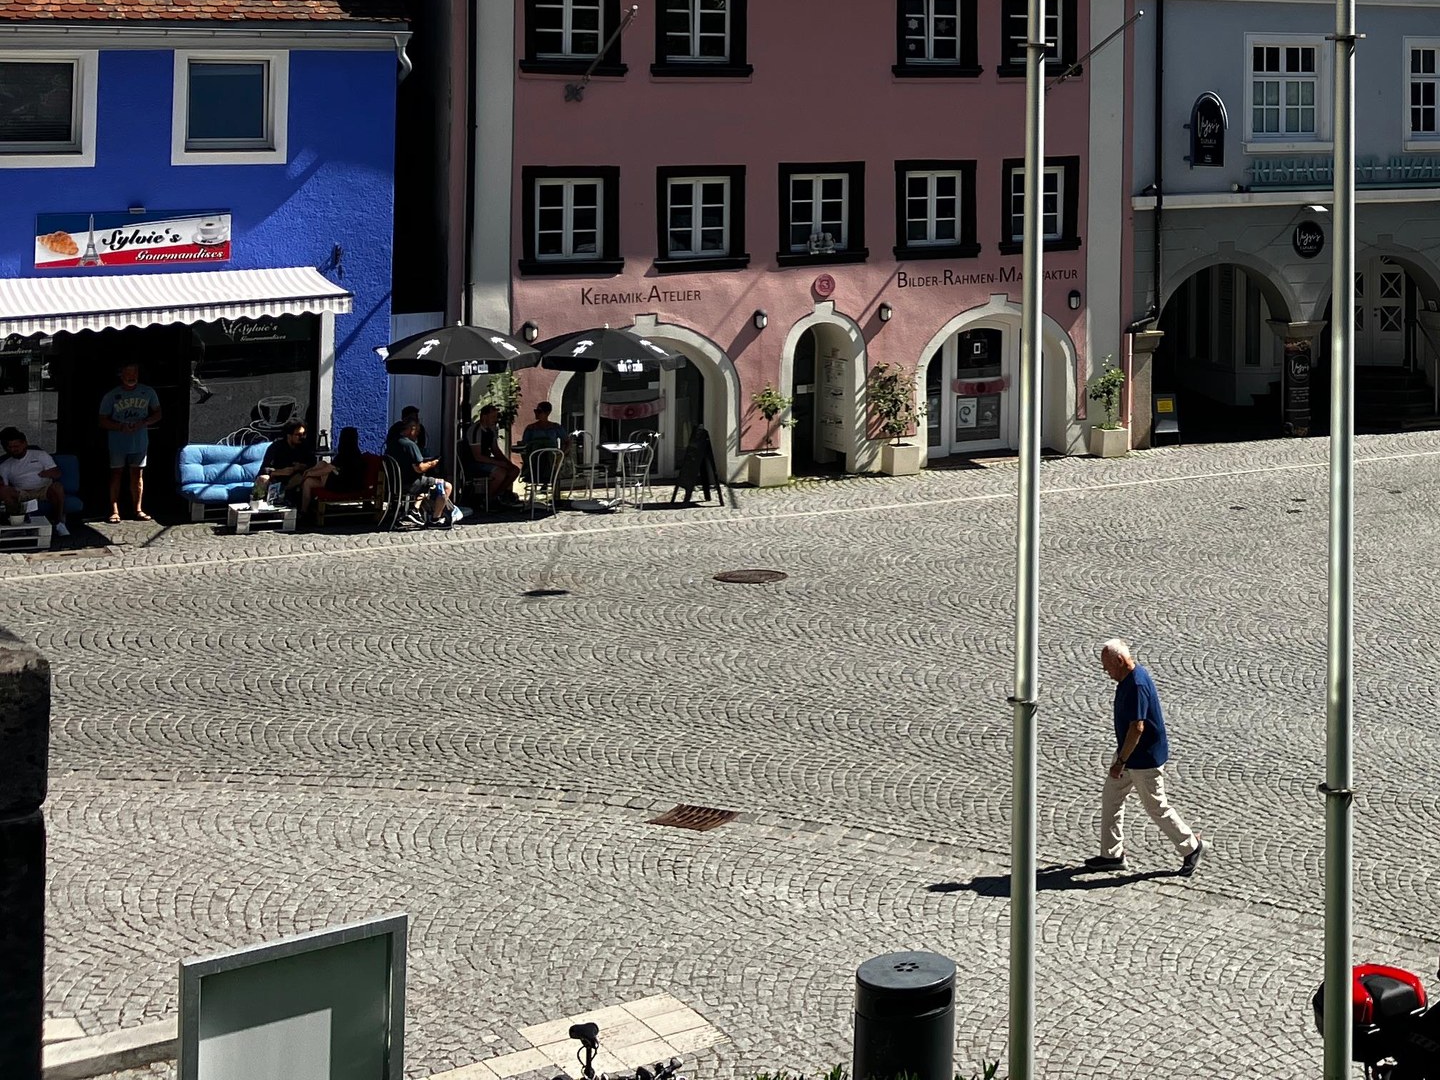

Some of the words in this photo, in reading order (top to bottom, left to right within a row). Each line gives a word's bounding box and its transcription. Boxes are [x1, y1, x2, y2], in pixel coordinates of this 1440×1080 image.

[134, 247, 225, 262] Gourmandises
[897, 266, 1079, 288] BILDER-RAHMEN-MAAKTUR
[581, 285, 702, 306] KERAMIK-ATELIER
